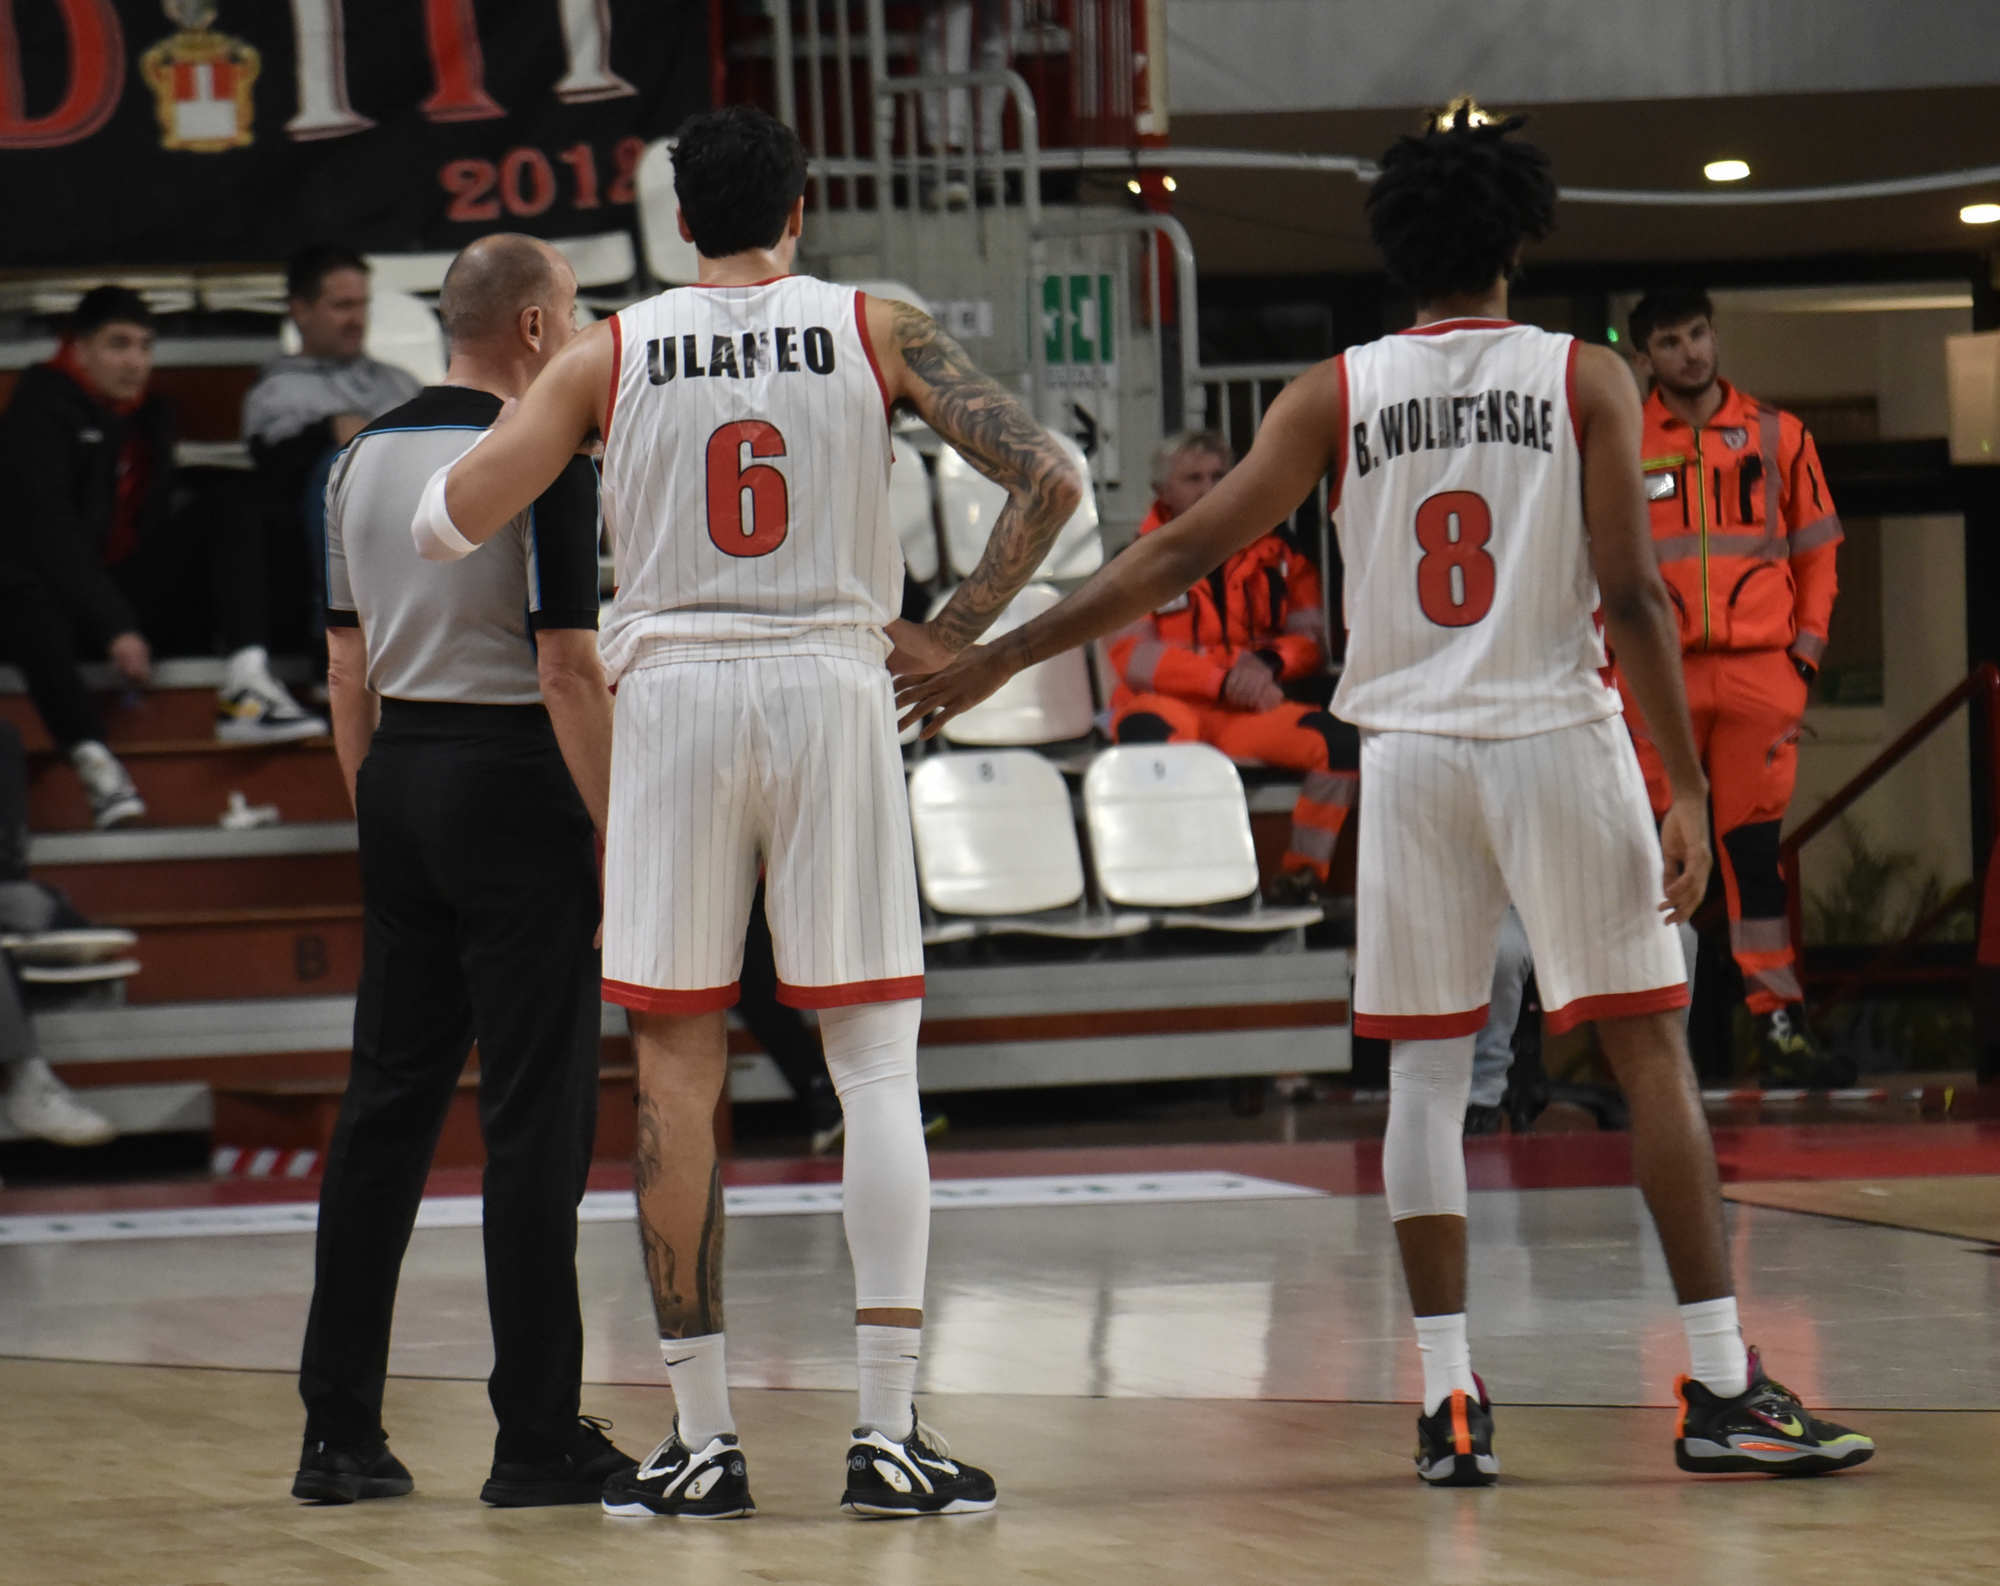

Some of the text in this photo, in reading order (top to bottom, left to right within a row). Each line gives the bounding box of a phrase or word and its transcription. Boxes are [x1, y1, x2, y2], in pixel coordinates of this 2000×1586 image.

[647, 326, 836, 386] ULANEO
[705, 419, 789, 558] 6
[1353, 421, 1380, 478] B.
[1415, 490, 1496, 628] 8
